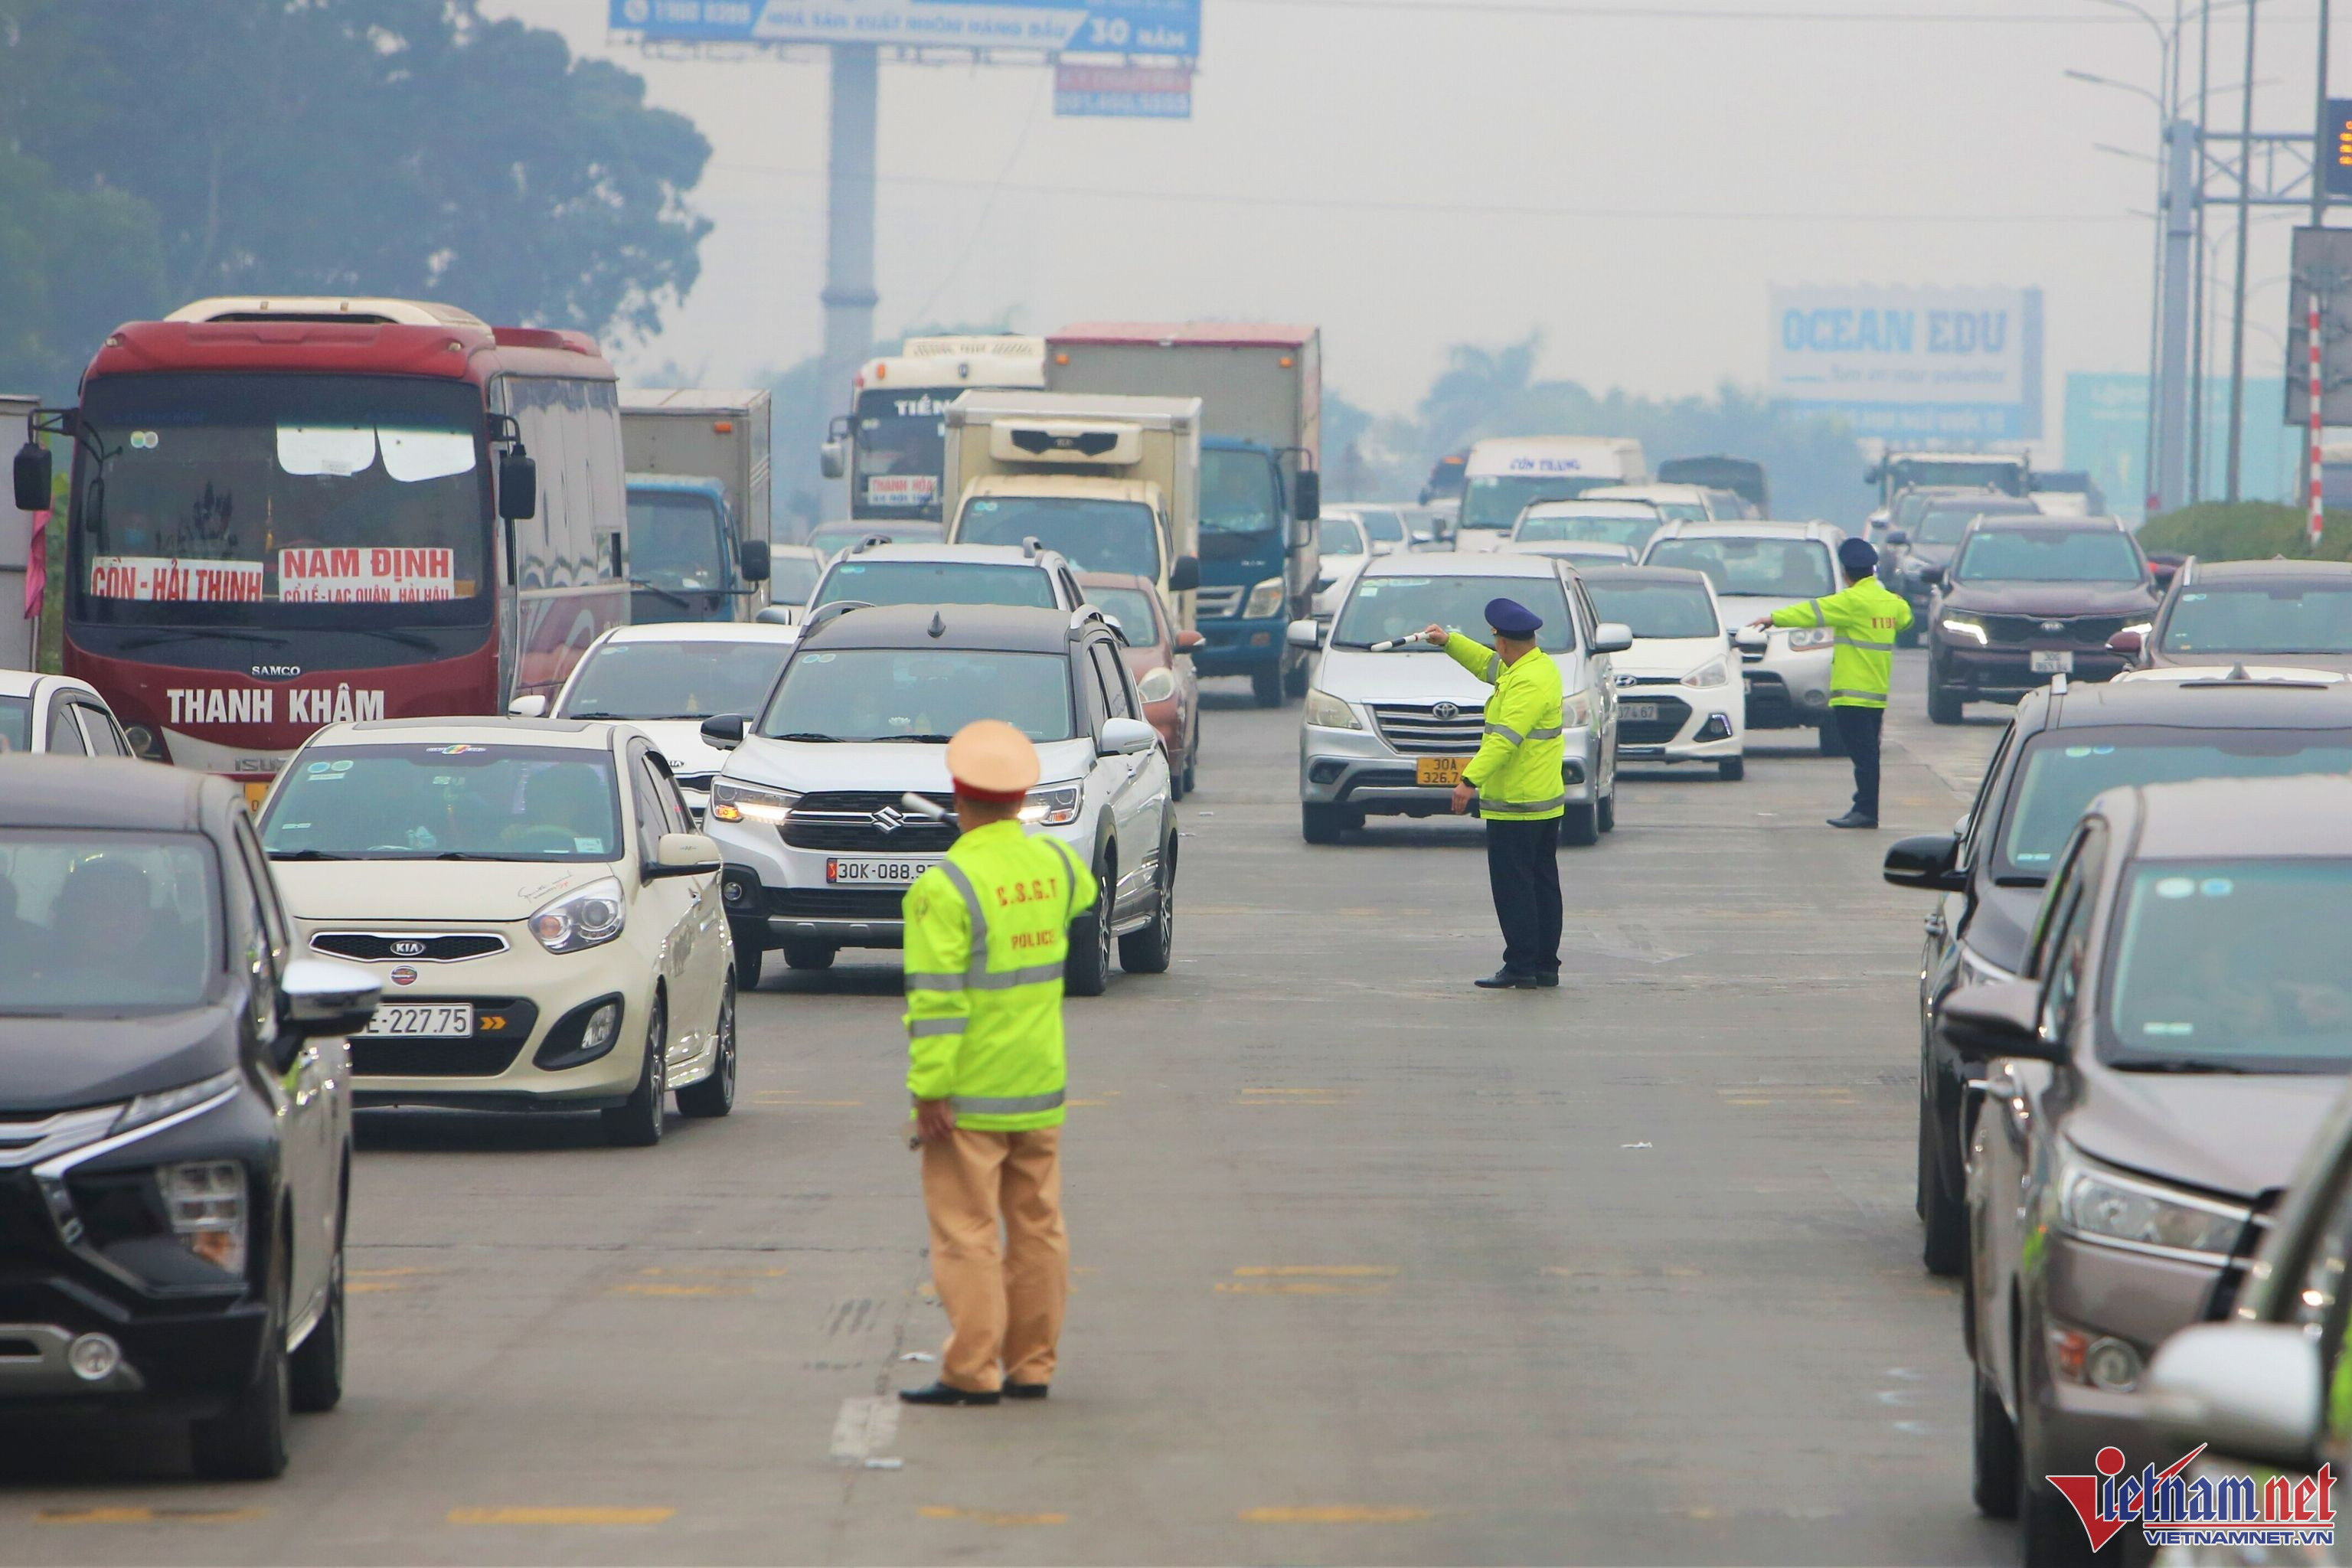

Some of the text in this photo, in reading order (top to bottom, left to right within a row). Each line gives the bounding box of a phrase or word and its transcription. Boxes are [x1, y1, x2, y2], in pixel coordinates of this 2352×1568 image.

[1090, 18, 1131, 44] 30
[1782, 308, 2007, 354] OCEAN EDU
[284, 549, 449, 583] NAM ĐỊNH
[252, 665, 301, 676] SAMCO
[167, 682, 384, 724] THANH KHÂM
[1433, 759, 1457, 770] 30A
[838, 863, 936, 879] 30K-088.9
[396, 942, 419, 952] KIA
